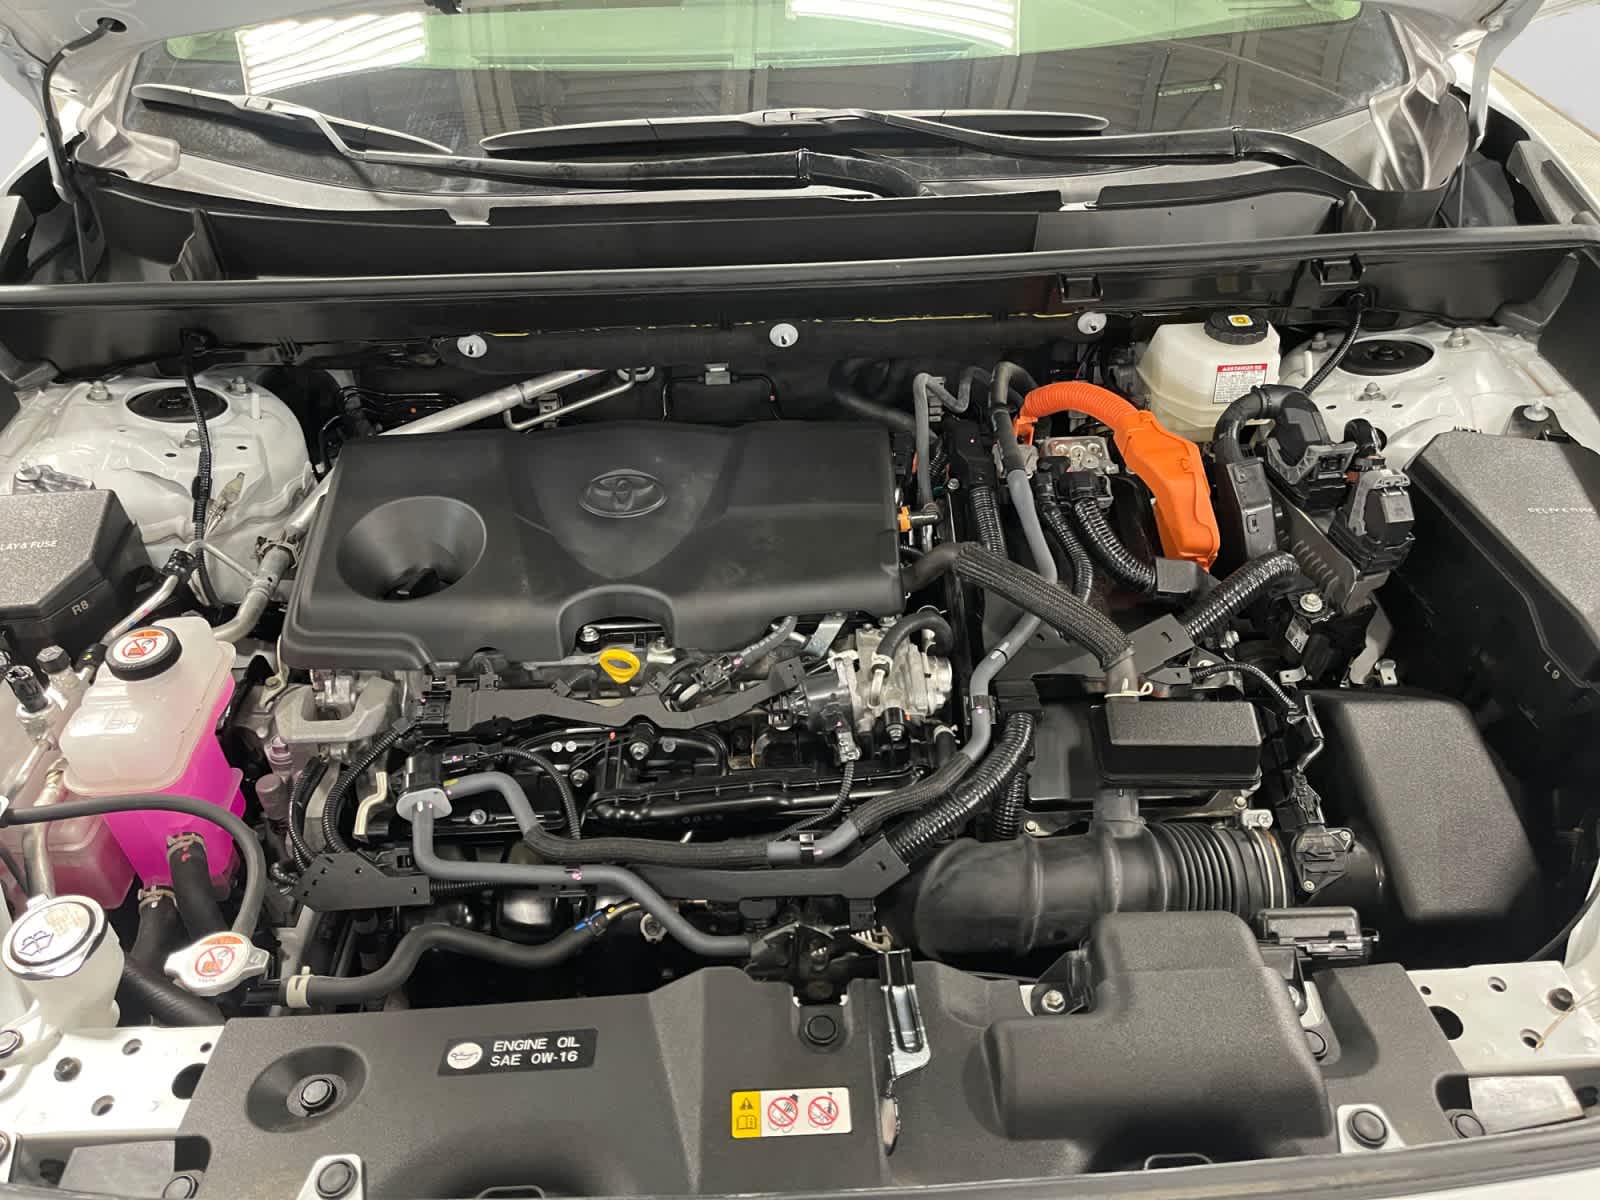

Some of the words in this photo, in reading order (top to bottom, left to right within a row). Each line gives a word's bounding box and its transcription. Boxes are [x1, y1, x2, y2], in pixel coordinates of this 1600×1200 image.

[30, 540, 58, 549] FUSE
[71, 600, 89, 616] R8
[493, 1038, 548, 1052] ENGINE
[556, 1036, 581, 1049] OIL
[489, 1054, 523, 1067] SAE
[530, 1050, 579, 1065] 0W-16
